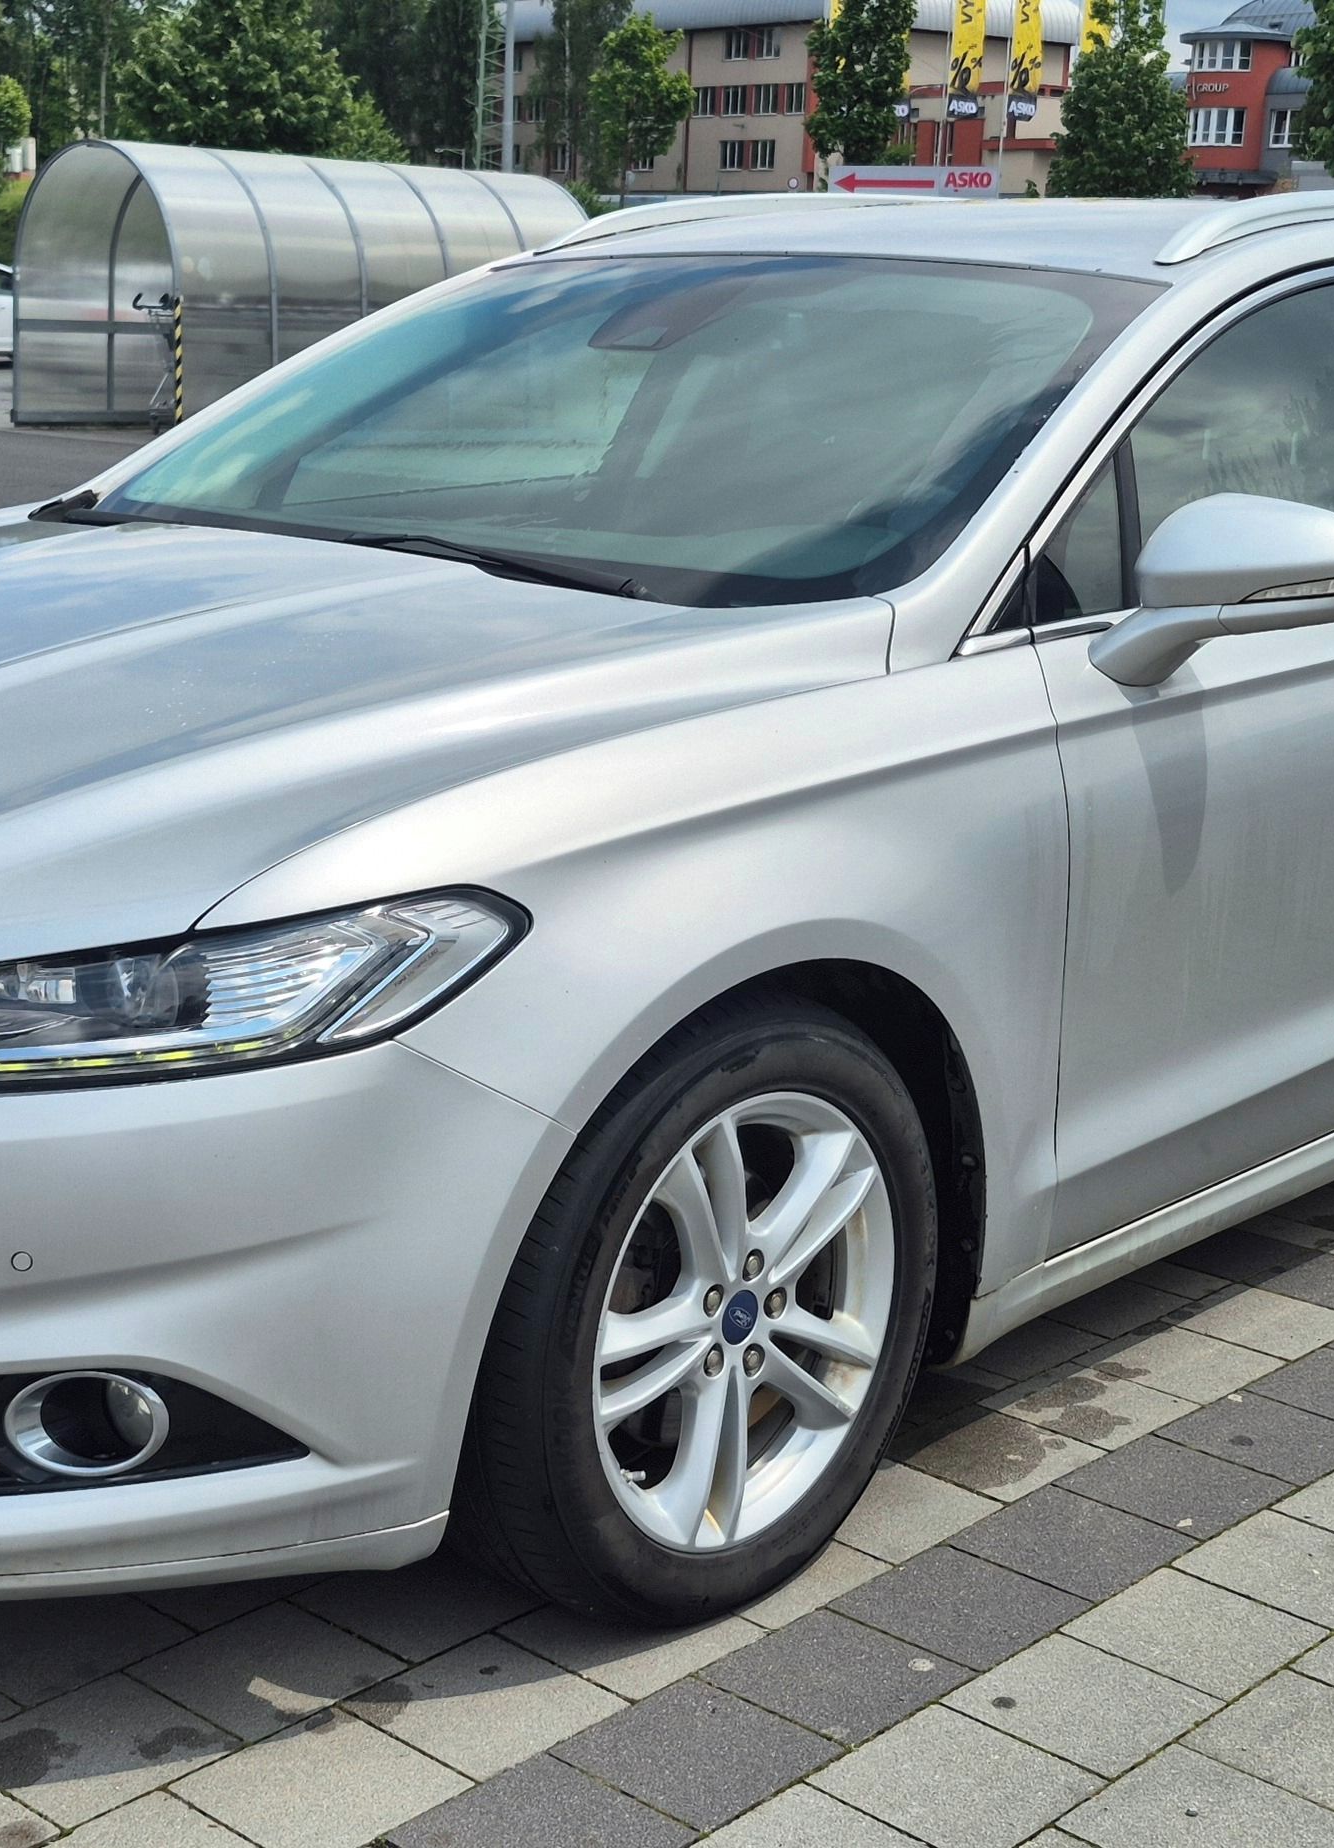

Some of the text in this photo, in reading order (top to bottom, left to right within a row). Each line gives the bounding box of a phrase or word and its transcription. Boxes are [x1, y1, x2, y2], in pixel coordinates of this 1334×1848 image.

[1196, 83, 1229, 93] GROUP
[949, 100, 977, 114] ASKO
[1009, 101, 1035, 116] ASKO
[945, 172, 992, 191] ASKO
